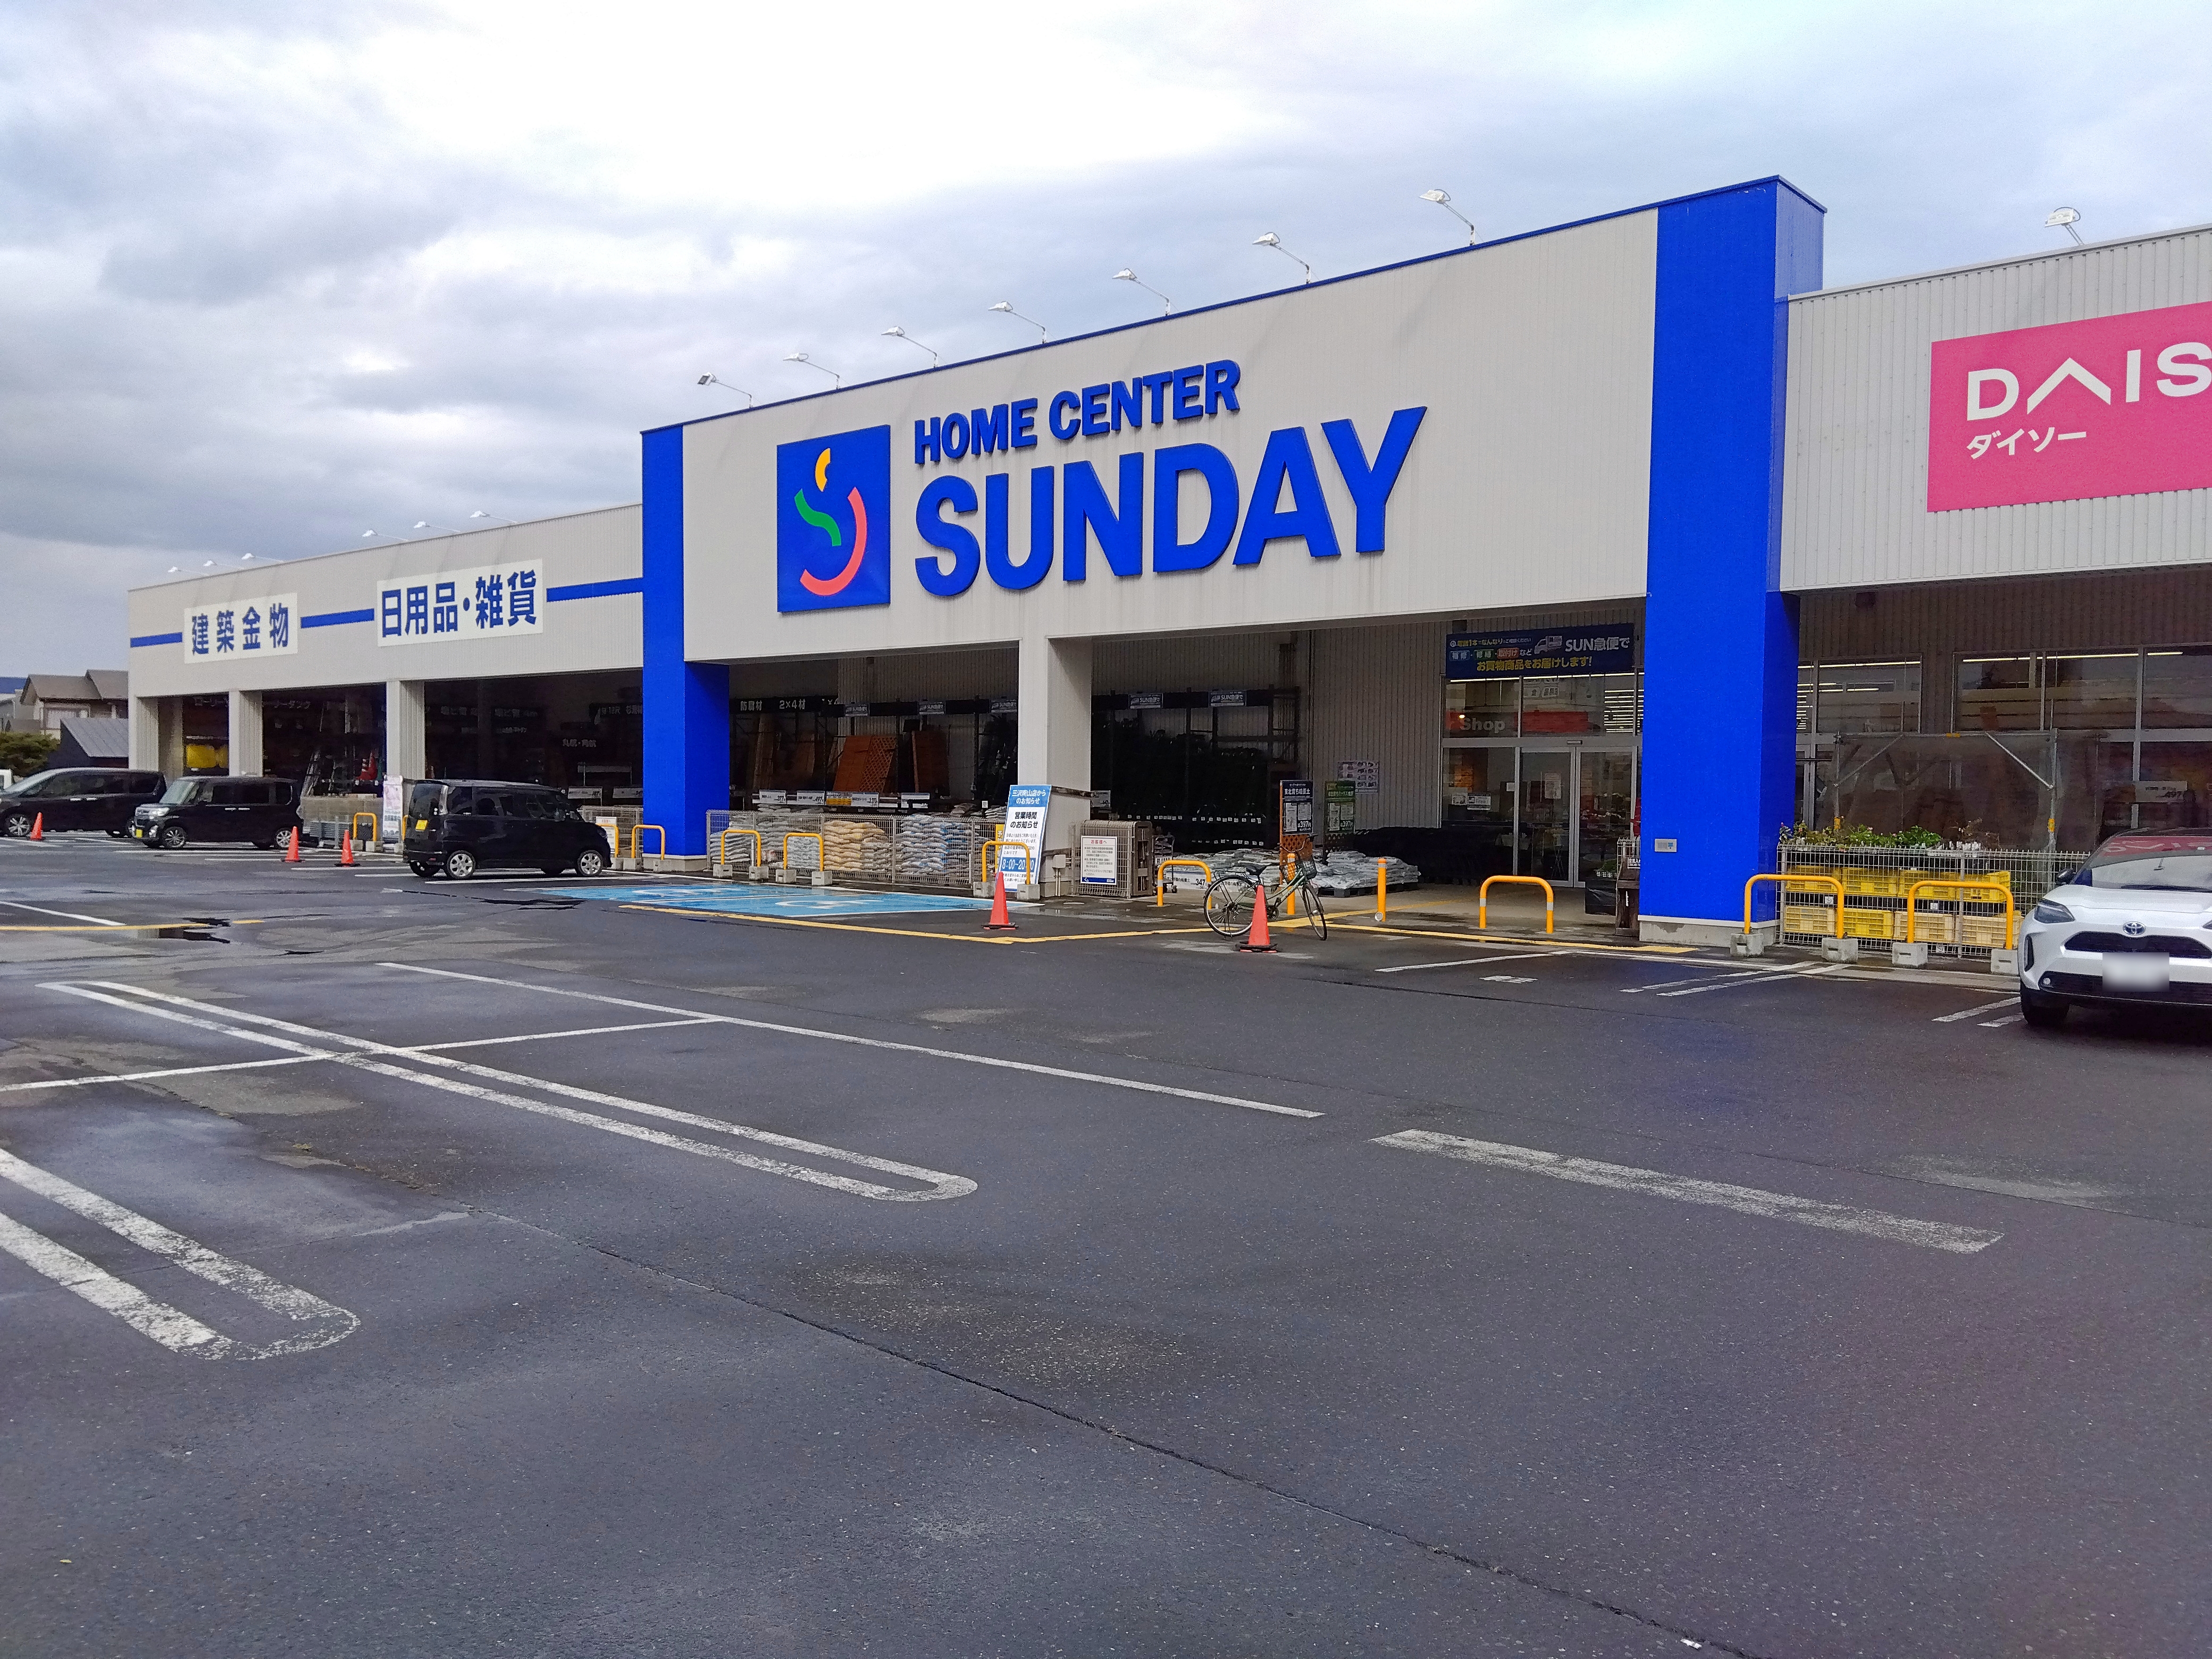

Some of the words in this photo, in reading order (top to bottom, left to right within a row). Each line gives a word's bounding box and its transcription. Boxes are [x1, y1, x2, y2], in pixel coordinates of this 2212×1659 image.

[915, 398, 1038, 464] HOME
[1049, 360, 1241, 440] CENTER
[1967, 428, 2087, 459] ダイソー
[916, 407, 1426, 596] SUNDAY
[192, 603, 288, 655] 建築金物
[382, 570, 537, 637] 日用品・雑貨
[1460, 717, 1505, 734] Shop
